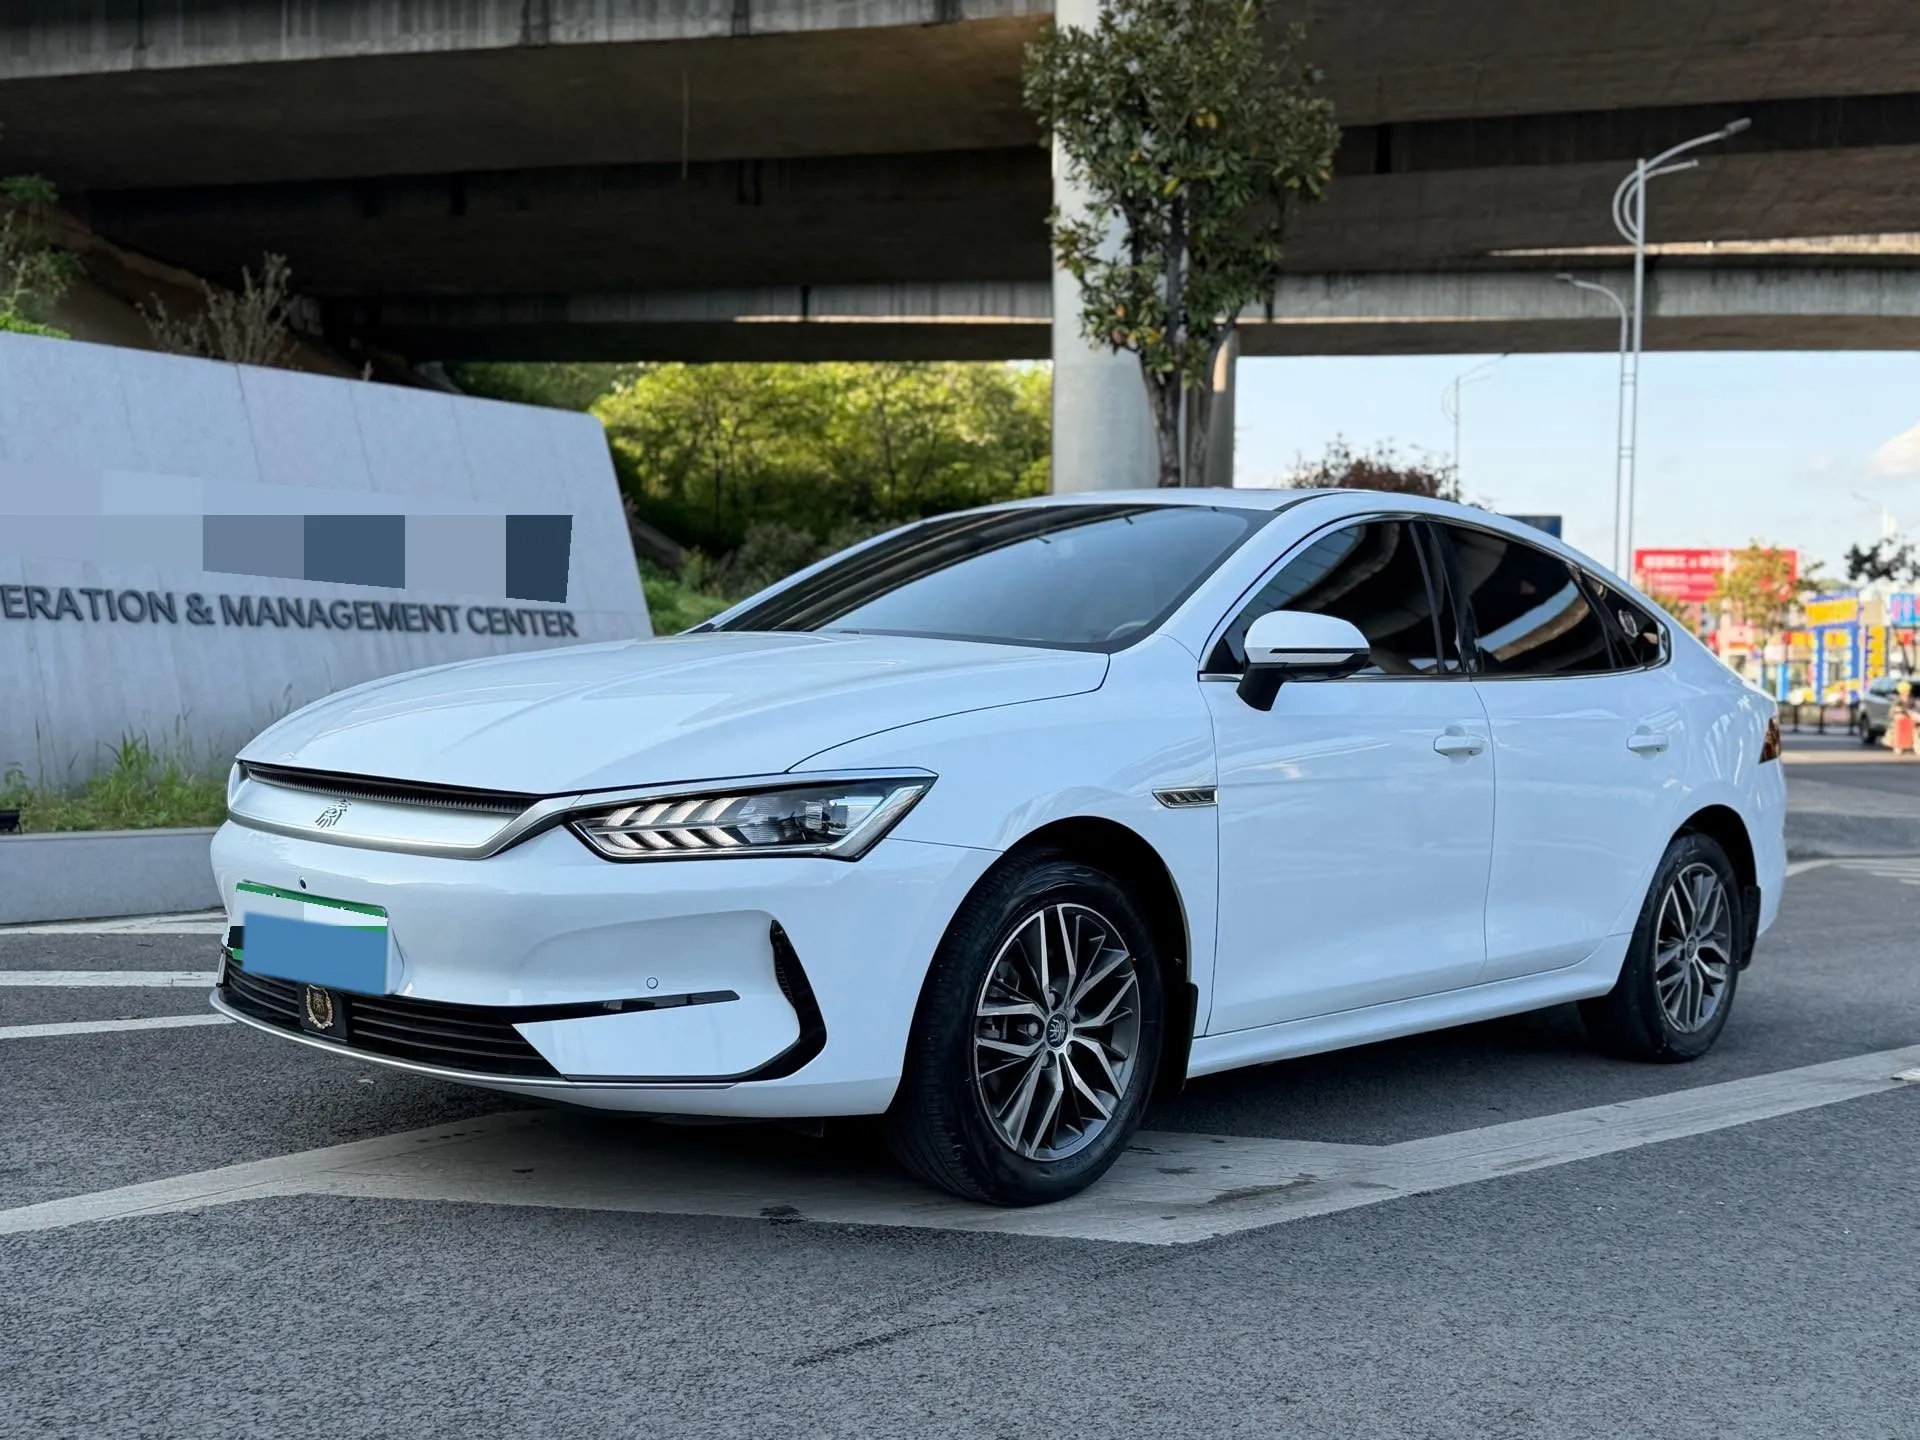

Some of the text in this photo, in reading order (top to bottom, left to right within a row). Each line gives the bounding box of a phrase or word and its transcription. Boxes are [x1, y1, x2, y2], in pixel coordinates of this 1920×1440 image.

[0, 584, 579, 638] ERATION & MANAGEMENT CENTER
